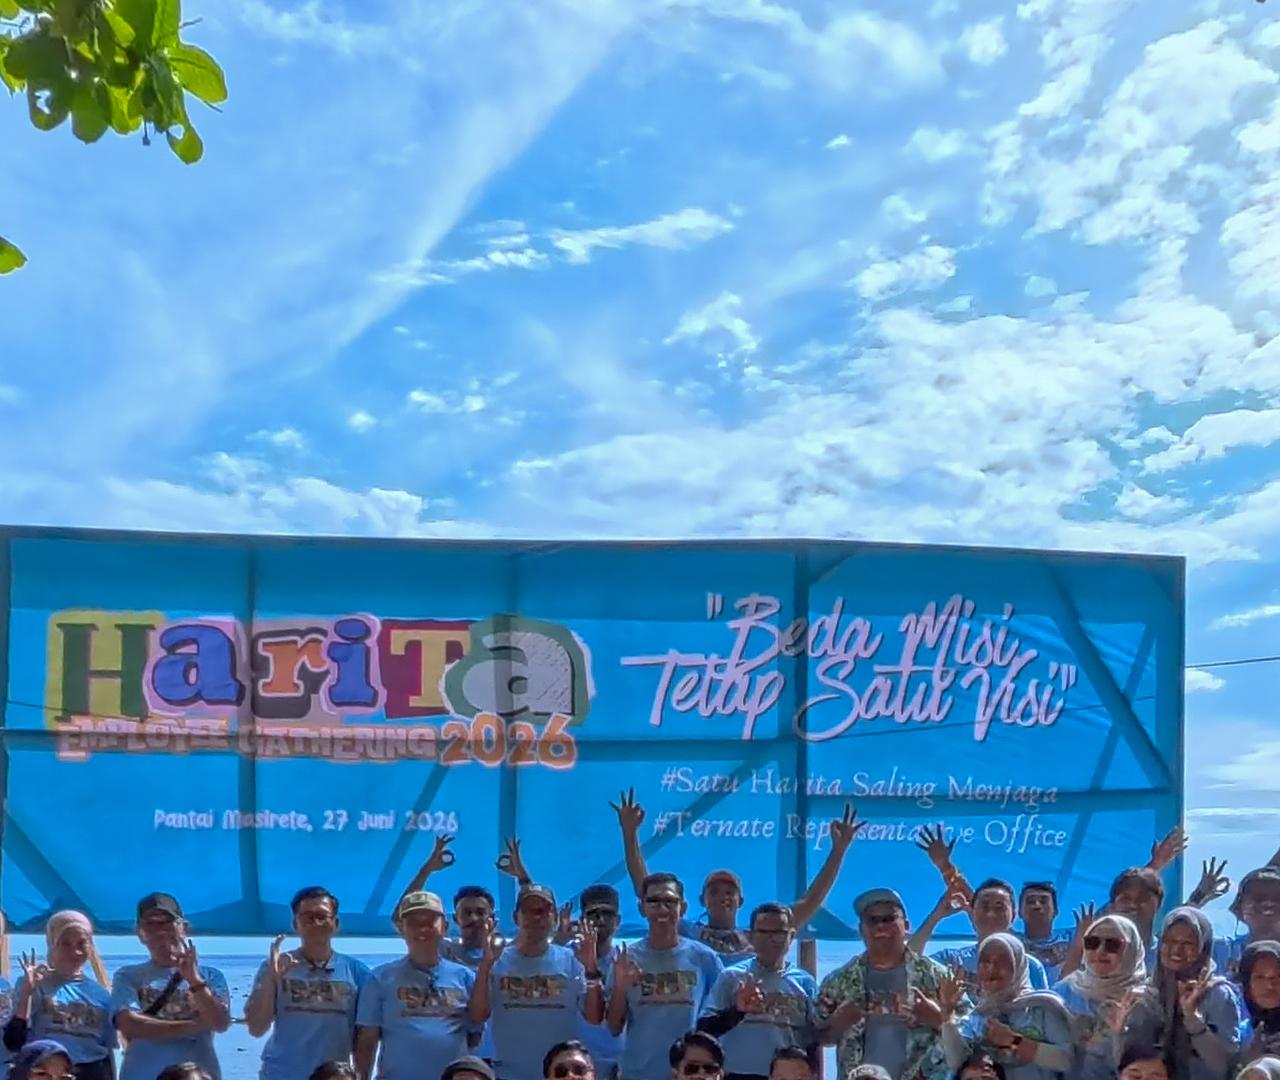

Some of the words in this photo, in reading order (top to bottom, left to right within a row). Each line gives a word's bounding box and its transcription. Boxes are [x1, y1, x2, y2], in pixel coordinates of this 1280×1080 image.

[898, 594, 1020, 688] Misi
[621, 649, 785, 740] Tetap
[793, 655, 956, 742] Satu
[440, 712, 578, 770] 2026
[660, 767, 739, 794] #Satu
[853, 766, 939, 809] Saling
[947, 776, 1058, 812] Menjaga
[154, 809, 214, 829] Pantai
[222, 811, 314, 832] Masirete,
[323, 810, 349, 830] 27
[357, 811, 395, 830] Juni
[404, 811, 459, 832] 2026
[652, 812, 775, 839] #Ternate
[984, 814, 1068, 853] Office
